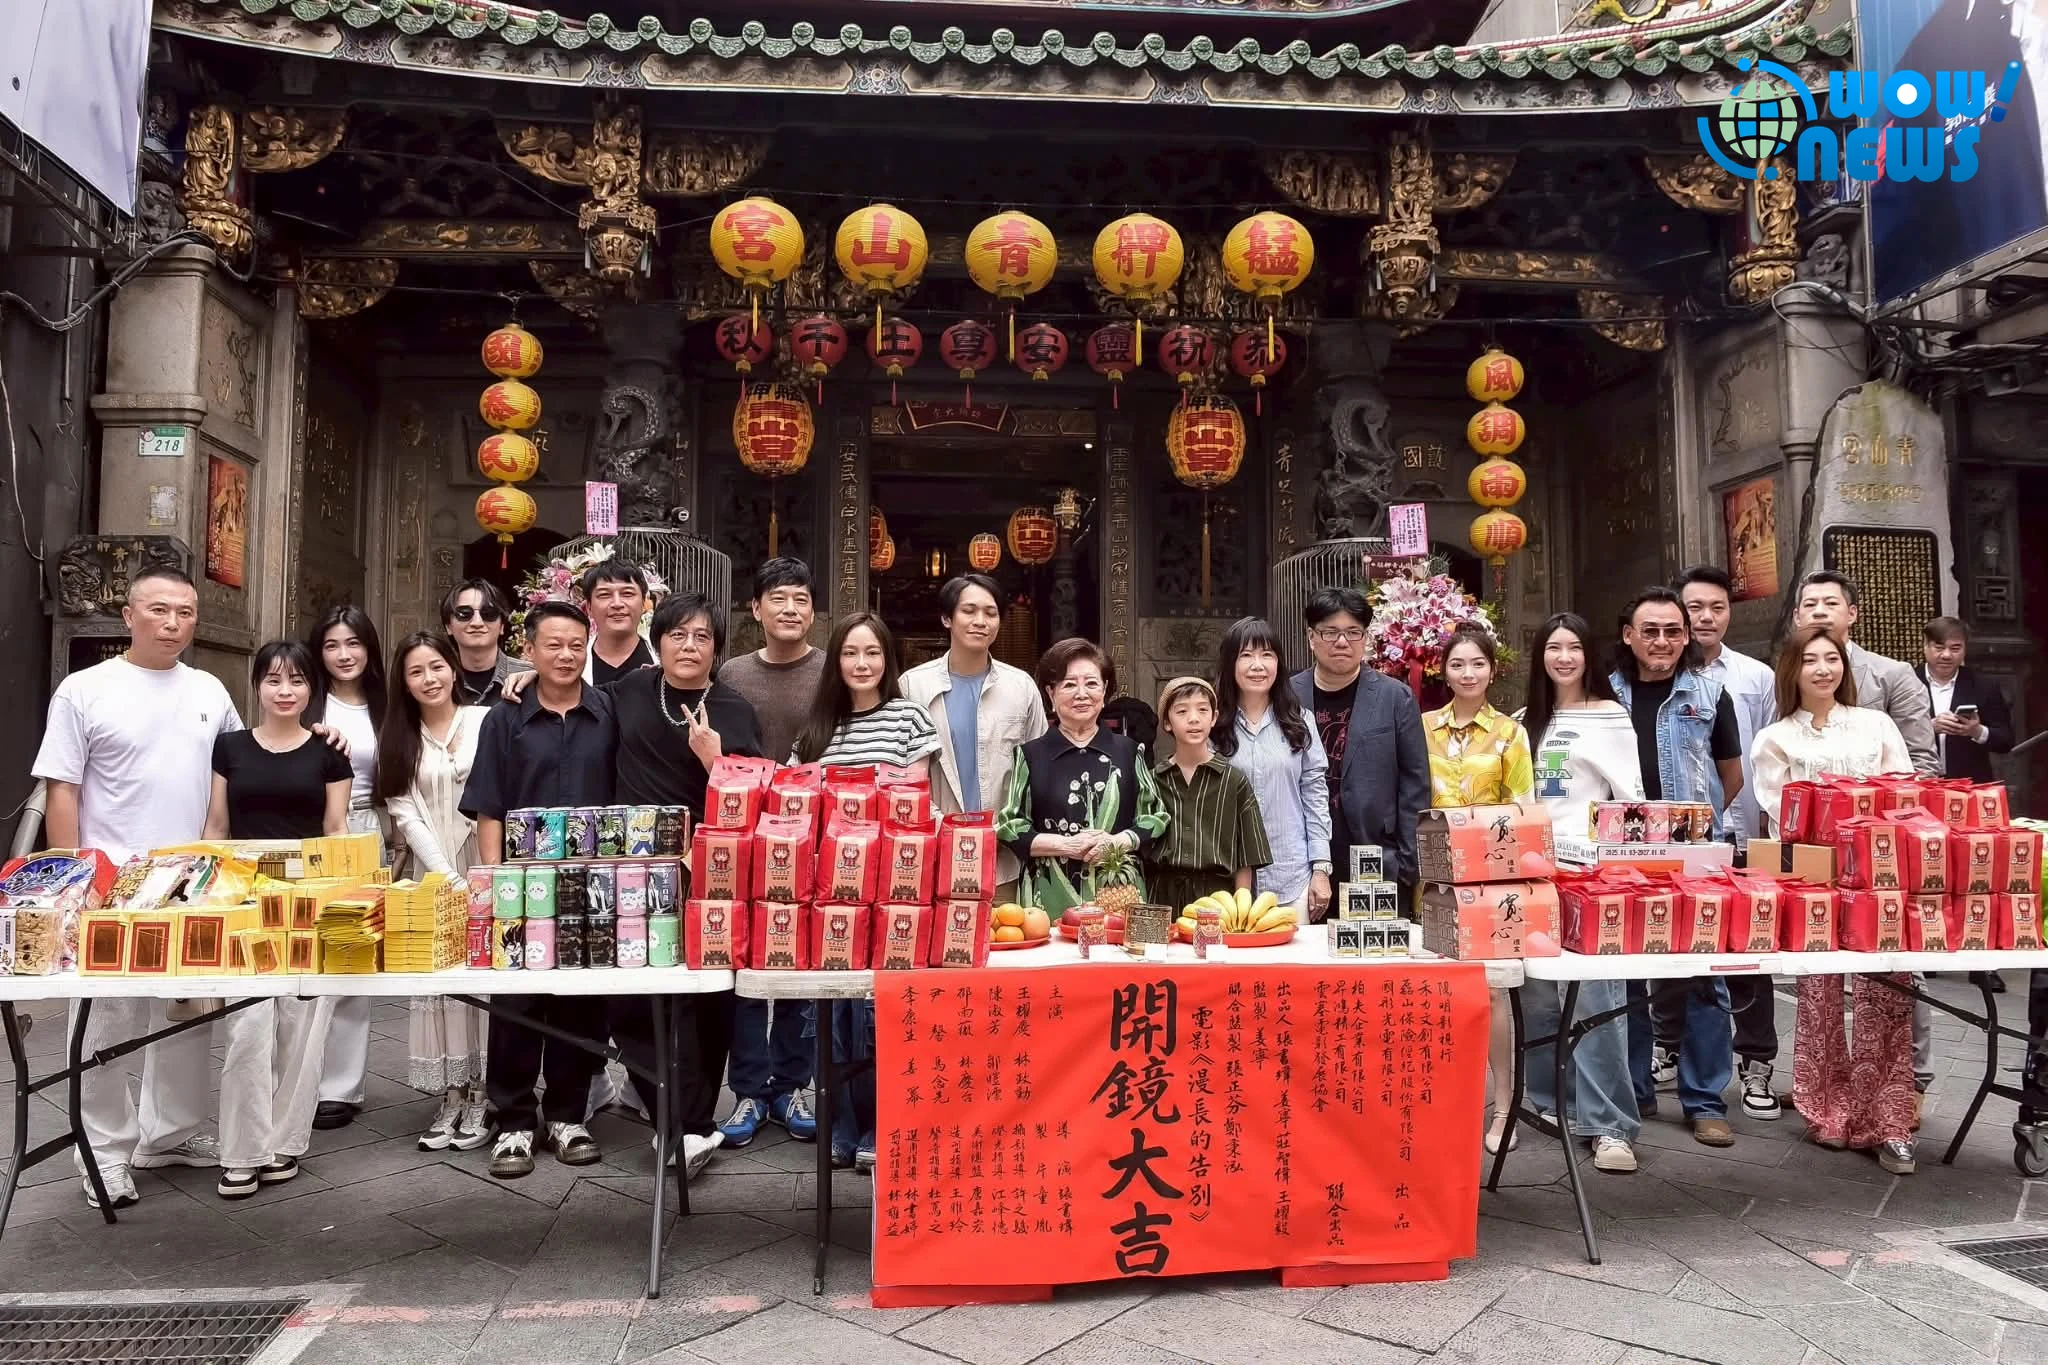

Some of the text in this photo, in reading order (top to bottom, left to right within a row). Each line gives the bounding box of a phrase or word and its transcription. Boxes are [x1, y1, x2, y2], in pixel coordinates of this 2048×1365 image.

[155, 439, 180, 452] 218
[1363, 861, 1378, 873] EX
[1352, 899, 1368, 911] EX
[1377, 898, 1393, 910] EX
[1340, 935, 1356, 946] EX
[1366, 935, 1382, 946] EX
[1390, 935, 1406, 945] EX
[1089, 978, 1185, 1275] 開鏡大吉
